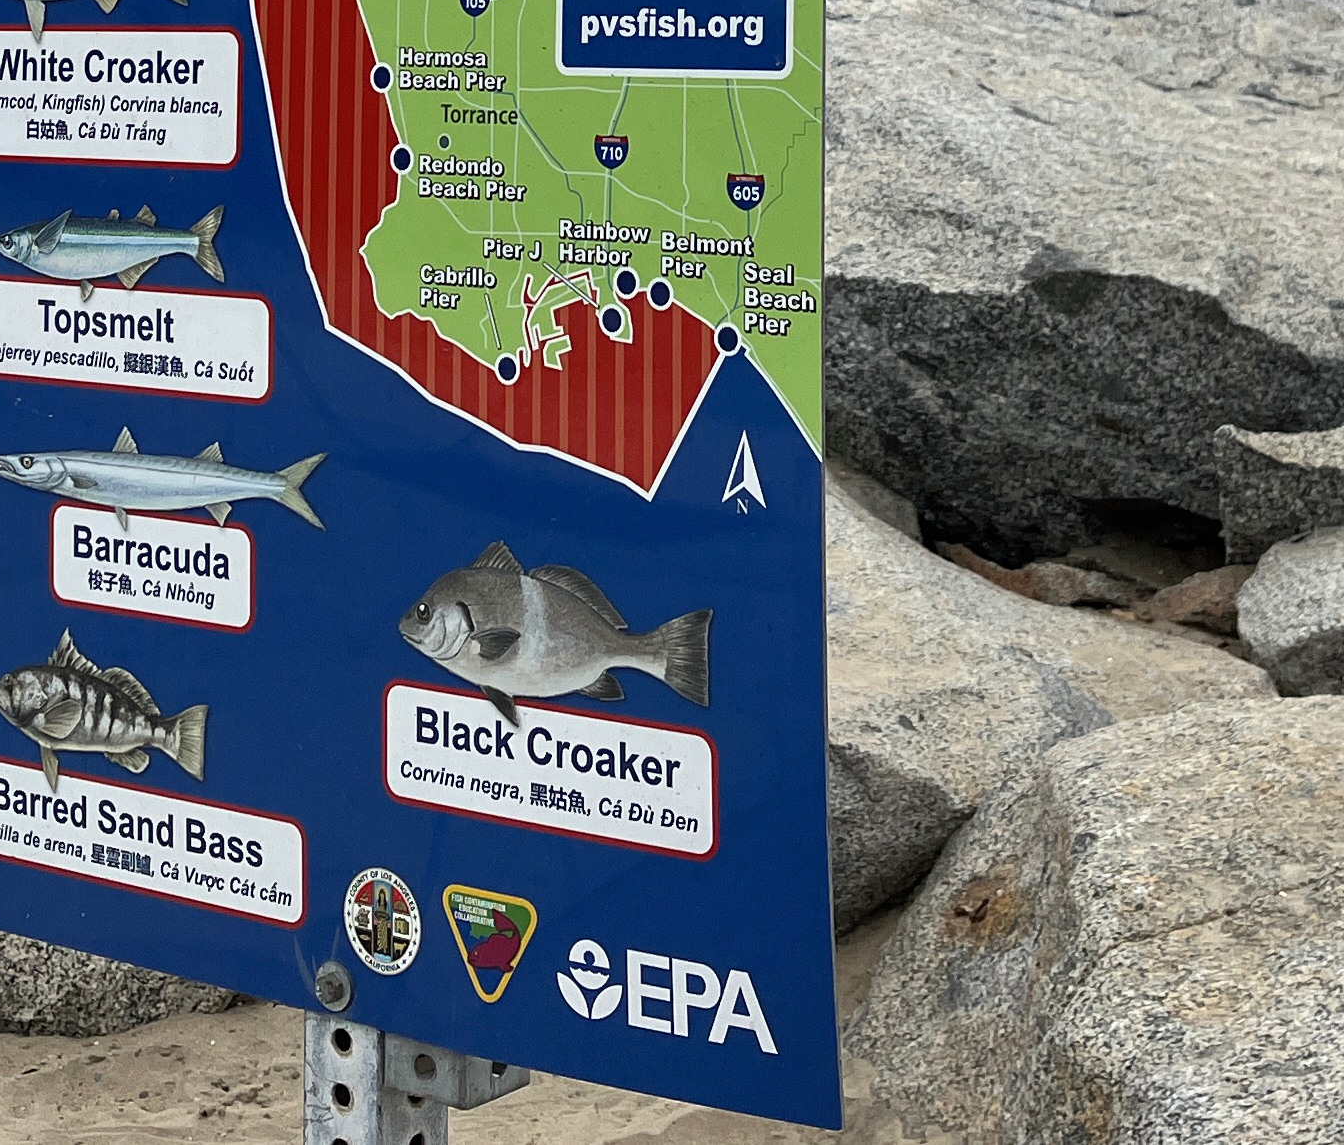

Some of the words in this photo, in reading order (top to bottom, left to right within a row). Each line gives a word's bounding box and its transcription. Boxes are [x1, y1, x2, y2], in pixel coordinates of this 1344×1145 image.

[581, 8, 764, 45] pvsfish.org
[84, 49, 204, 84] Croaker
[400, 49, 487, 68] Hermosa
[399, 71, 458, 90] Beach
[465, 72, 506, 92] Pier
[42, 93, 105, 115] Kingfish)
[110, 96, 165, 112] Corvina
[170, 97, 223, 117] blanca,
[441, 104, 518, 125] Torrance
[78, 122, 95, 139] Cá
[101, 122, 120, 140] Đù
[601, 146, 622, 160] 710
[418, 156, 504, 175] Redondo
[418, 178, 480, 198] Beach
[485, 181, 526, 201] Pier
[733, 186, 759, 201] 605
[559, 221, 650, 244] Rainbow
[483, 240, 524, 259] Pier
[529, 241, 542, 259] J
[661, 232, 754, 255] Belmont
[559, 245, 630, 265] Harbor
[420, 266, 496, 287] Cabrillo
[661, 257, 704, 278] Pier
[744, 264, 793, 283] Seal
[420, 289, 458, 308] Pier
[744, 289, 815, 311] Beach
[38, 299, 174, 343] Topsmelt
[744, 315, 790, 335] Pier
[44, 350, 119, 373] pescadillo,
[194, 360, 213, 378] Cá
[73, 524, 230, 580] Barracuda
[143, 579, 160, 597] Cá
[416, 706, 515, 760] Black
[527, 727, 681, 788] Croaker
[400, 760, 464, 788] Corvina
[470, 775, 524, 804] negra,
[599, 796, 622, 818] Cá
[628, 803, 654, 824] Đù
[661, 809, 698, 832] Đen
[98, 799, 174, 848] Sand
[185, 819, 264, 867] Bass
[24, 829, 40, 848] de
[45, 834, 87, 861] arena,
[160, 861, 179, 880] Cá
[230, 877, 256, 898] Cát
[626, 949, 778, 1055] EPA
